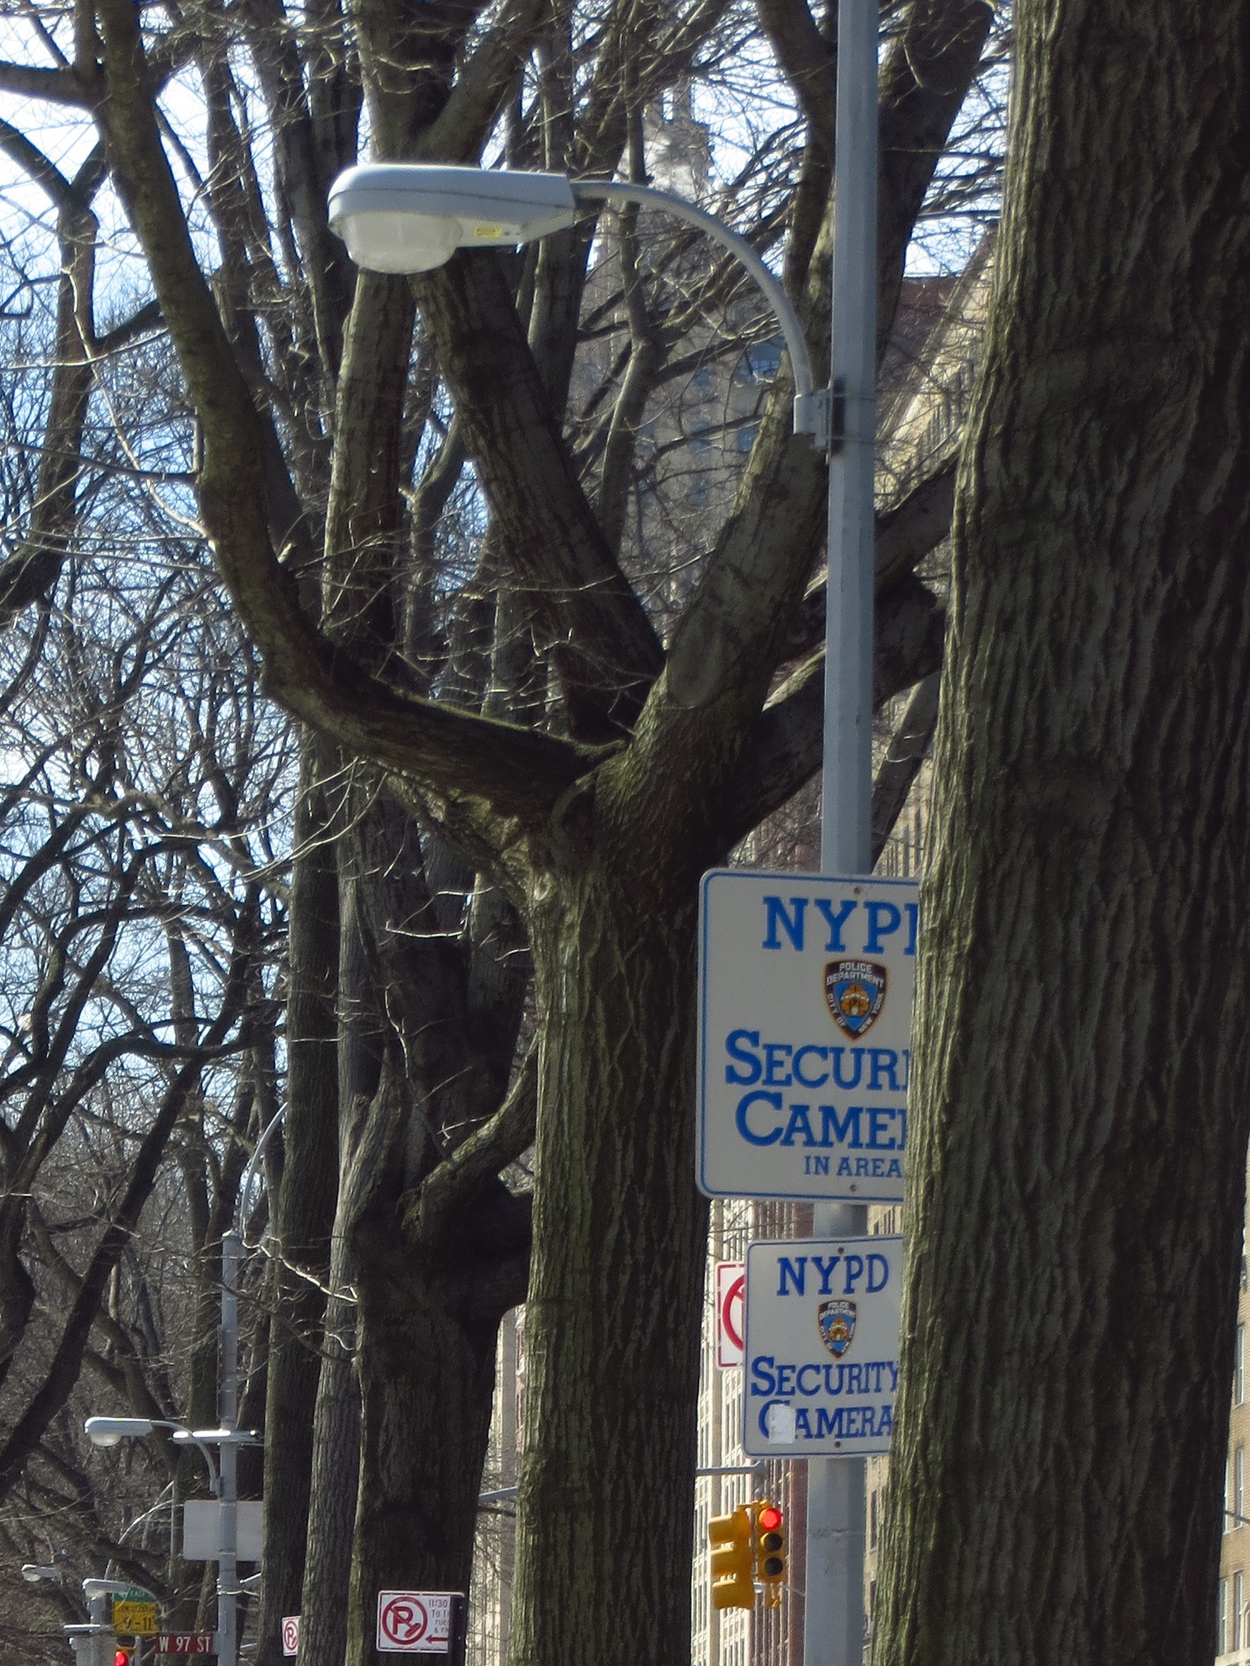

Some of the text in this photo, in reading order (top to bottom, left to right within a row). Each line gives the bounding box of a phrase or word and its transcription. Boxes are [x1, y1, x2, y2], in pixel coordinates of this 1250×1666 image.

[838, 962, 872, 974] POLICE
[826, 971, 884, 988] DEPARTMENT
[827, 993, 839, 1014] CITY
[804, 1155, 903, 1179] IN AREA
[776, 1253, 889, 1297] NYPD
[751, 1355, 899, 1397] SECURITY
[428, 1599, 448, 1608] 11:30
[159, 1636, 211, 1653] W 97 ST
